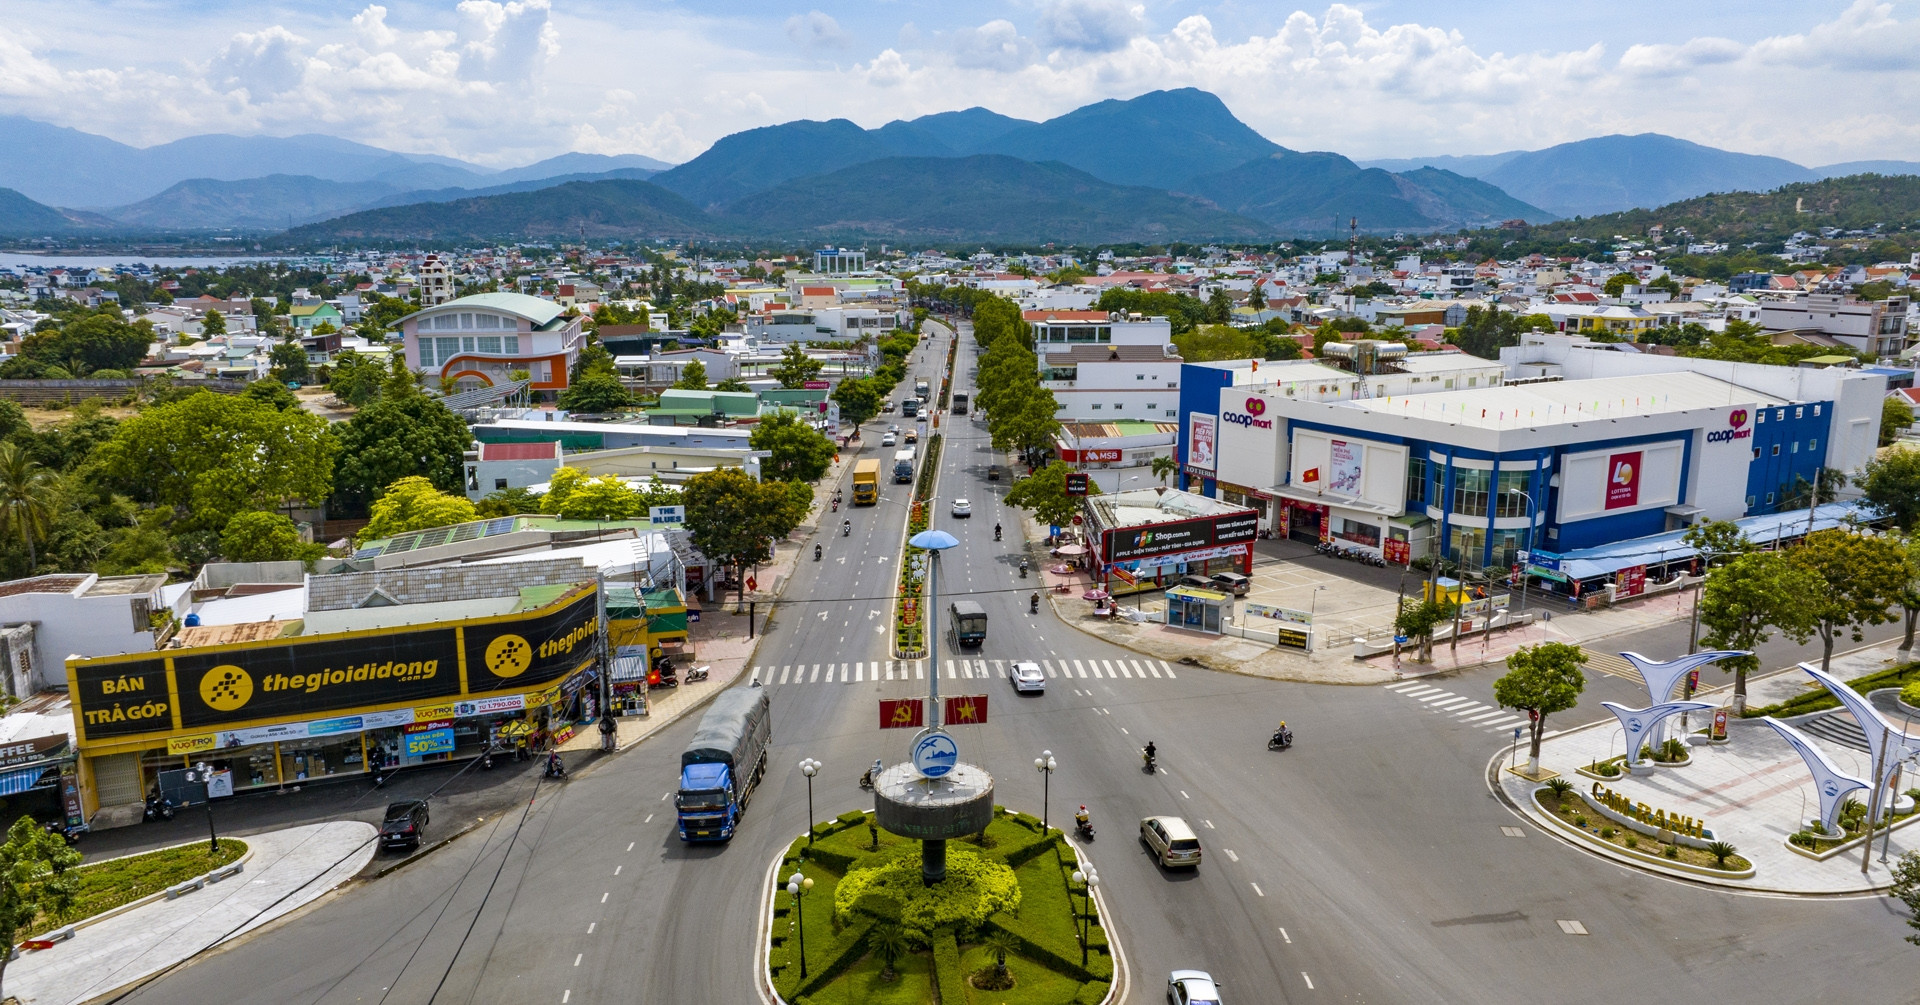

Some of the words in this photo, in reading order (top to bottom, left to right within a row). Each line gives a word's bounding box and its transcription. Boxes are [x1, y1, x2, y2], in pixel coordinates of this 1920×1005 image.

[1187, 466, 1214, 477] LOTTERIA
[1156, 531, 1190, 540] Shop.com.vn
[263, 660, 438, 693] thegioididong
[102, 675, 144, 695] BÁN
[488, 700, 521, 708] 1.790.000
[85, 703, 125, 724] TRẢ
[127, 701, 168, 720] GÓP
[410, 740, 437, 753] 50%
[1592, 781, 1631, 816] CAM
[1635, 802, 1703, 839] RANH
